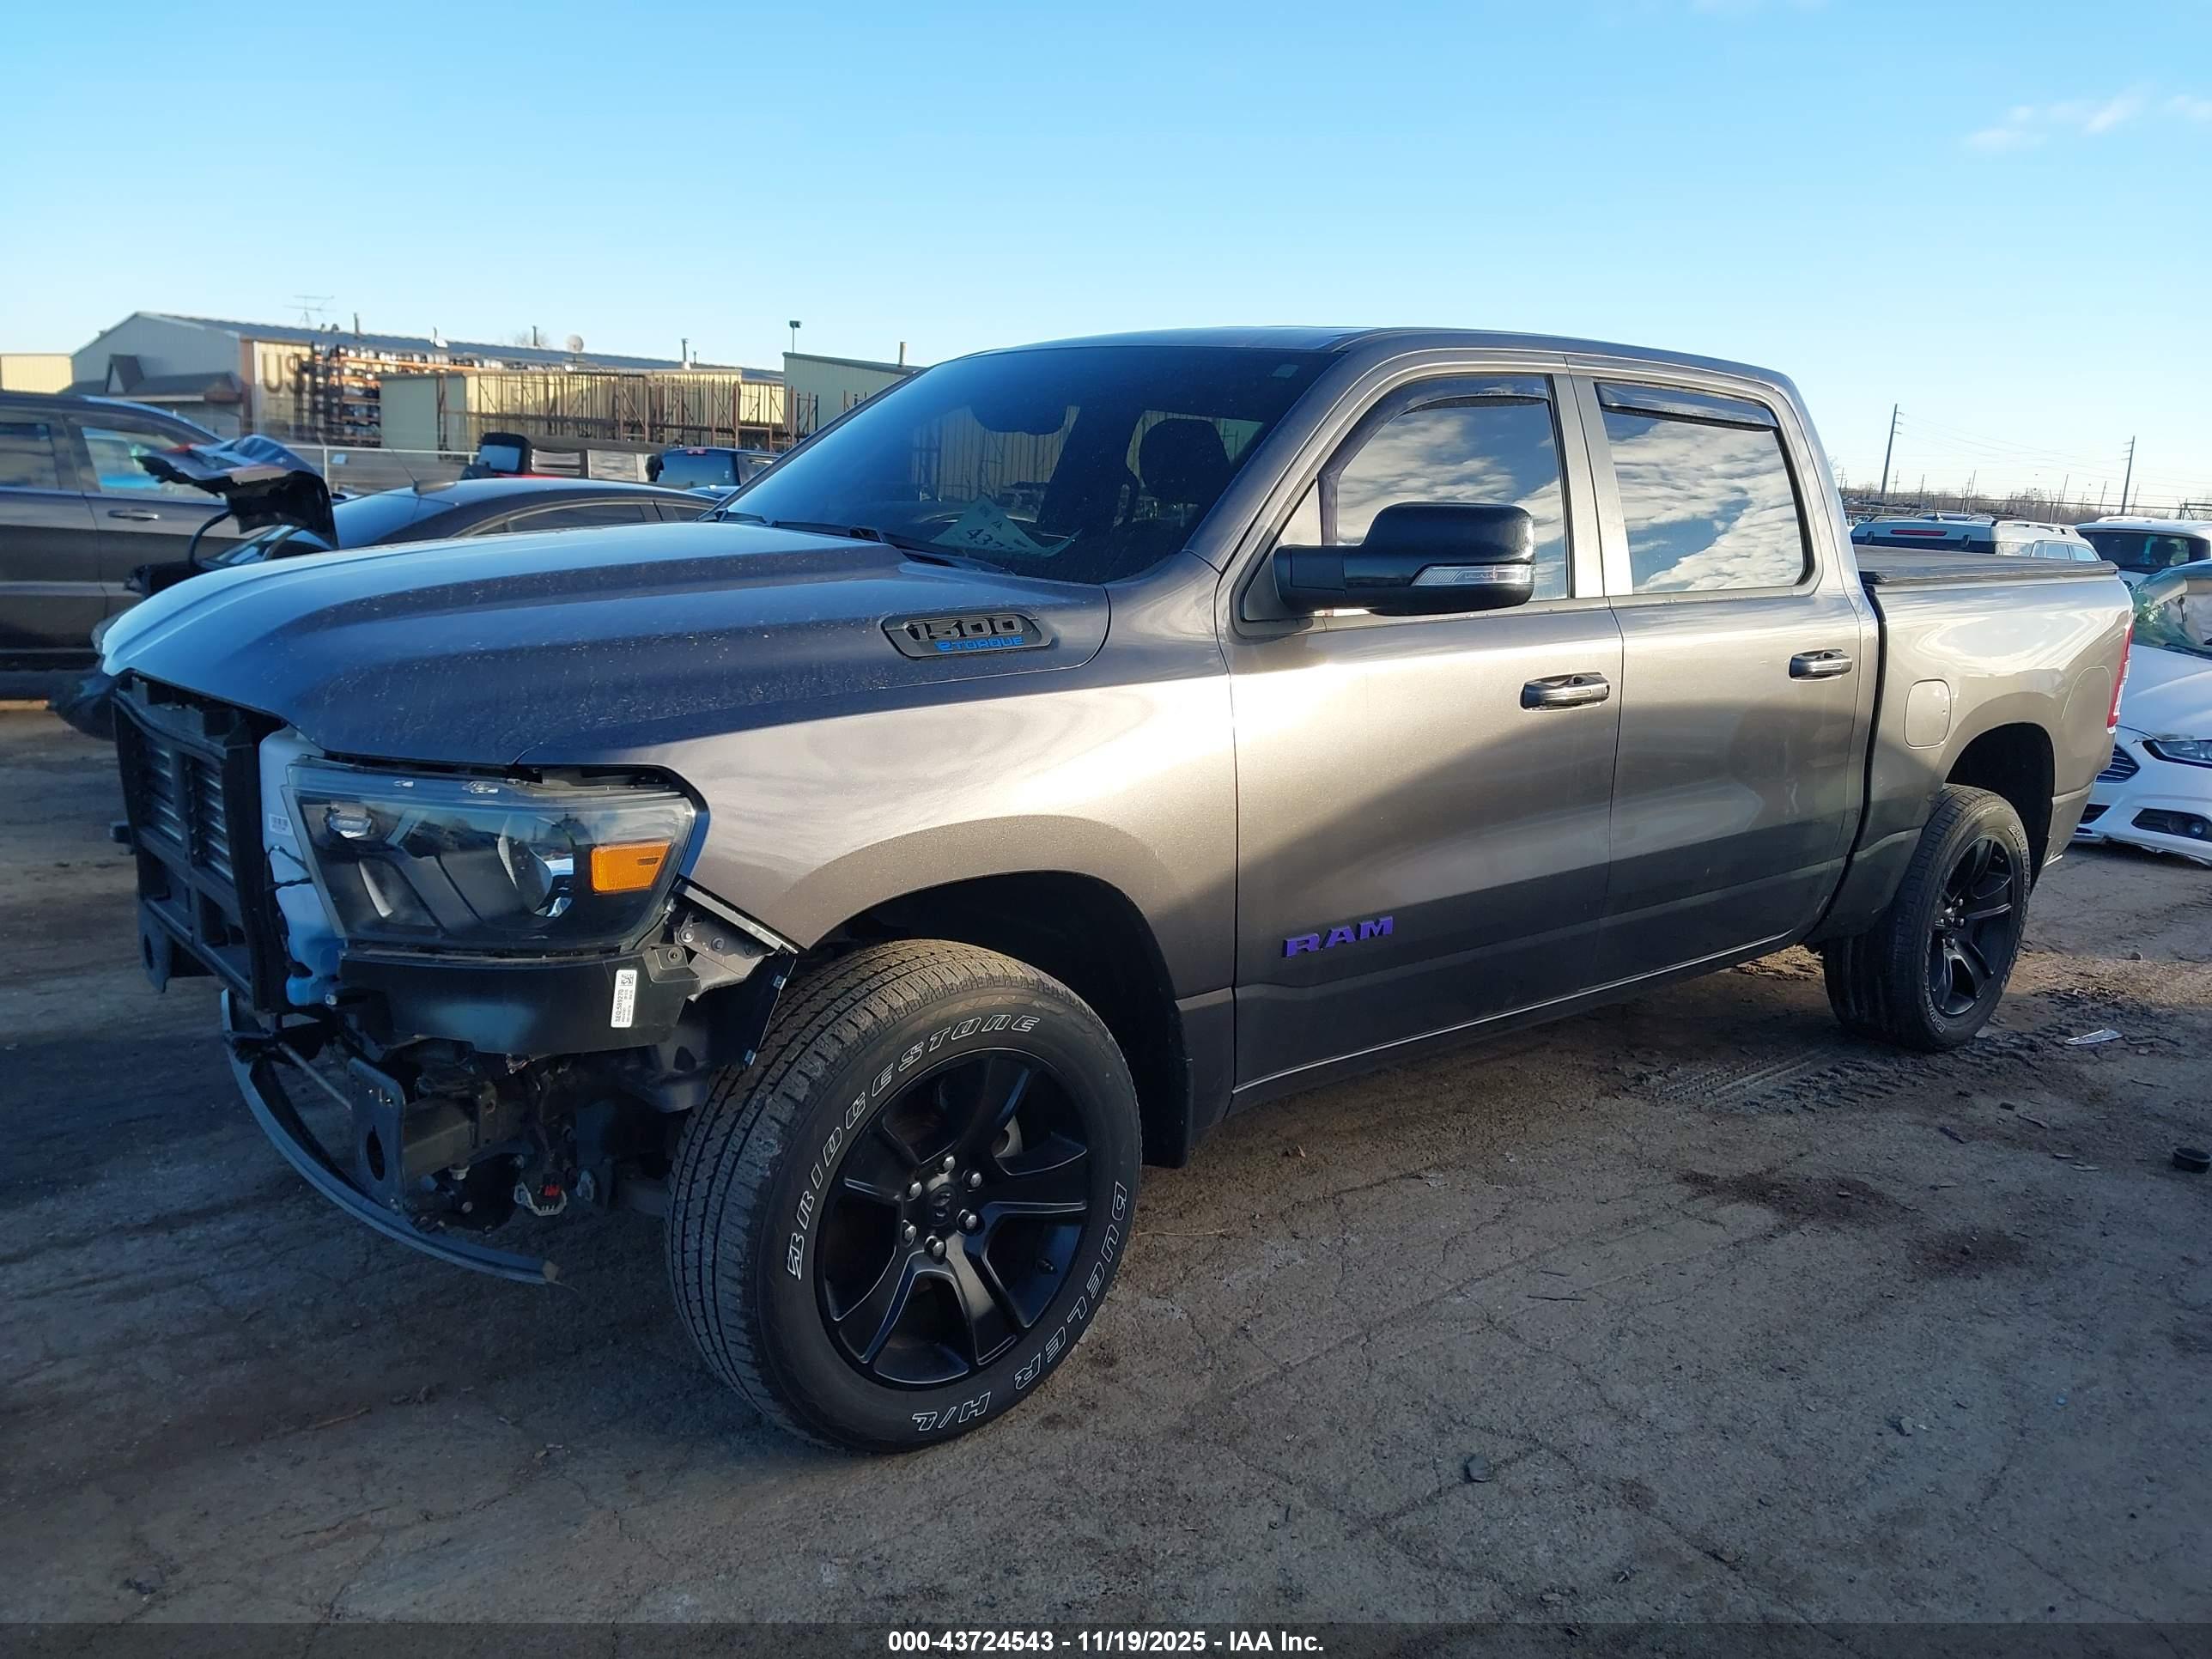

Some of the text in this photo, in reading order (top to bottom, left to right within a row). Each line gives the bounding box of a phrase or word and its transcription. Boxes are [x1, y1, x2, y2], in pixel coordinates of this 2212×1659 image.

[904, 615, 1024, 642] 1500
[1282, 915, 1394, 957] RAM
[787, 1013, 1041, 1281] BRIDGESTONE
[911, 1181, 1127, 1432] DUELER H/L
